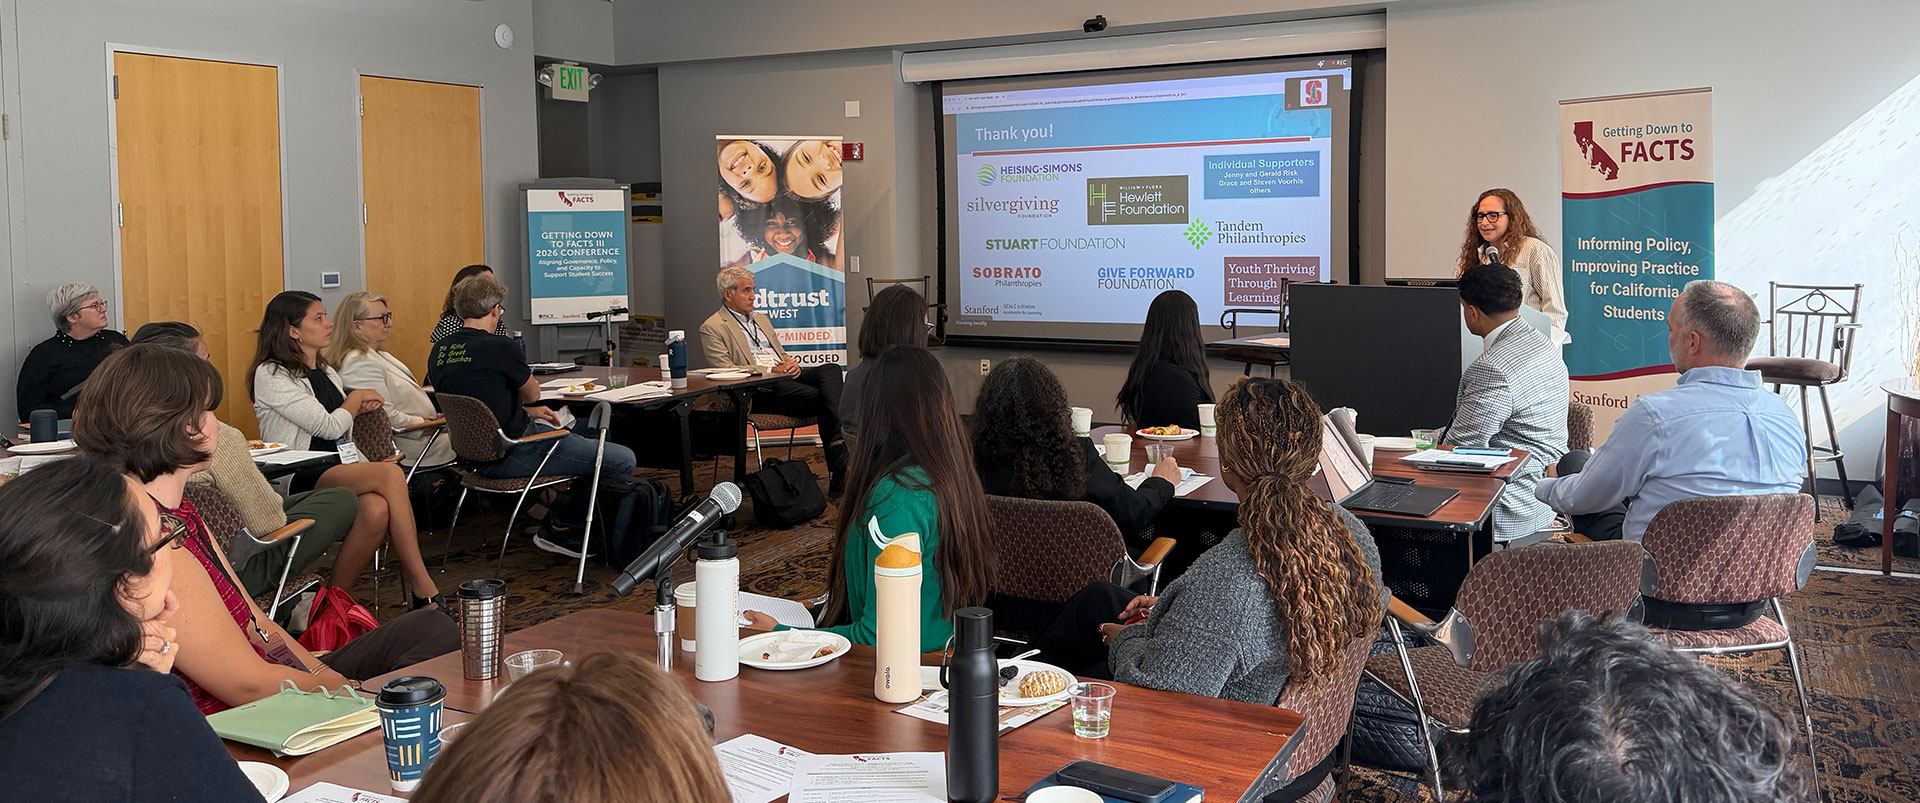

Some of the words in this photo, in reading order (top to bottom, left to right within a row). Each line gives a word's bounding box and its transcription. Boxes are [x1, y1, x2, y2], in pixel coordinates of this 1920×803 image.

[560, 67, 583, 90] EXIT
[975, 125, 1018, 141] Thank
[1022, 124, 1054, 146] you!
[1602, 126, 1642, 138] Getting
[1646, 124, 1678, 134] Down
[1680, 122, 1693, 133] to
[1621, 138, 1694, 162] FACTS
[1000, 164, 1082, 174] HEISING-SIMONS
[1208, 160, 1256, 170] Individual
[1258, 158, 1315, 169] Supporters
[1000, 173, 1059, 182] FOUNDATION
[1120, 192, 1162, 202] Hewlett
[967, 196, 1060, 214] silvergiving
[1120, 204, 1184, 214] Foundation
[1215, 220, 1264, 232] Tandem
[542, 232, 582, 240] GETTING
[1218, 232, 1306, 246] Philanthropies
[551, 240, 564, 248] TO
[986, 238, 1038, 250] STUART
[1040, 238, 1126, 250] FOUNDATION
[1578, 236, 1642, 254] Informing
[1646, 237, 1692, 255] Policy,
[560, 248, 620, 256] CONFERENCE
[972, 267, 1042, 278] SOBRATO
[1098, 268, 1126, 278] GIVE
[1130, 268, 1195, 278] FORWARD
[1228, 264, 1262, 274] Youth
[1264, 264, 1316, 276] Thriving
[1572, 260, 1638, 276] Improving
[1642, 260, 1700, 276] Practice
[995, 280, 1042, 288] Philanthropies
[1098, 278, 1175, 290] FOUNDATION
[1228, 278, 1277, 290] Through
[1590, 282, 1608, 295] for
[1612, 282, 1680, 298] California
[752, 288, 830, 308] dtrust
[1228, 292, 1280, 304] Learning
[768, 308, 798, 318] WEST
[964, 305, 999, 314] Stanford
[1603, 304, 1665, 320] Students
[446, 356, 472, 364] Gauchos
[790, 354, 840, 364] OCUSED
[1572, 390, 1628, 408] Stanford
